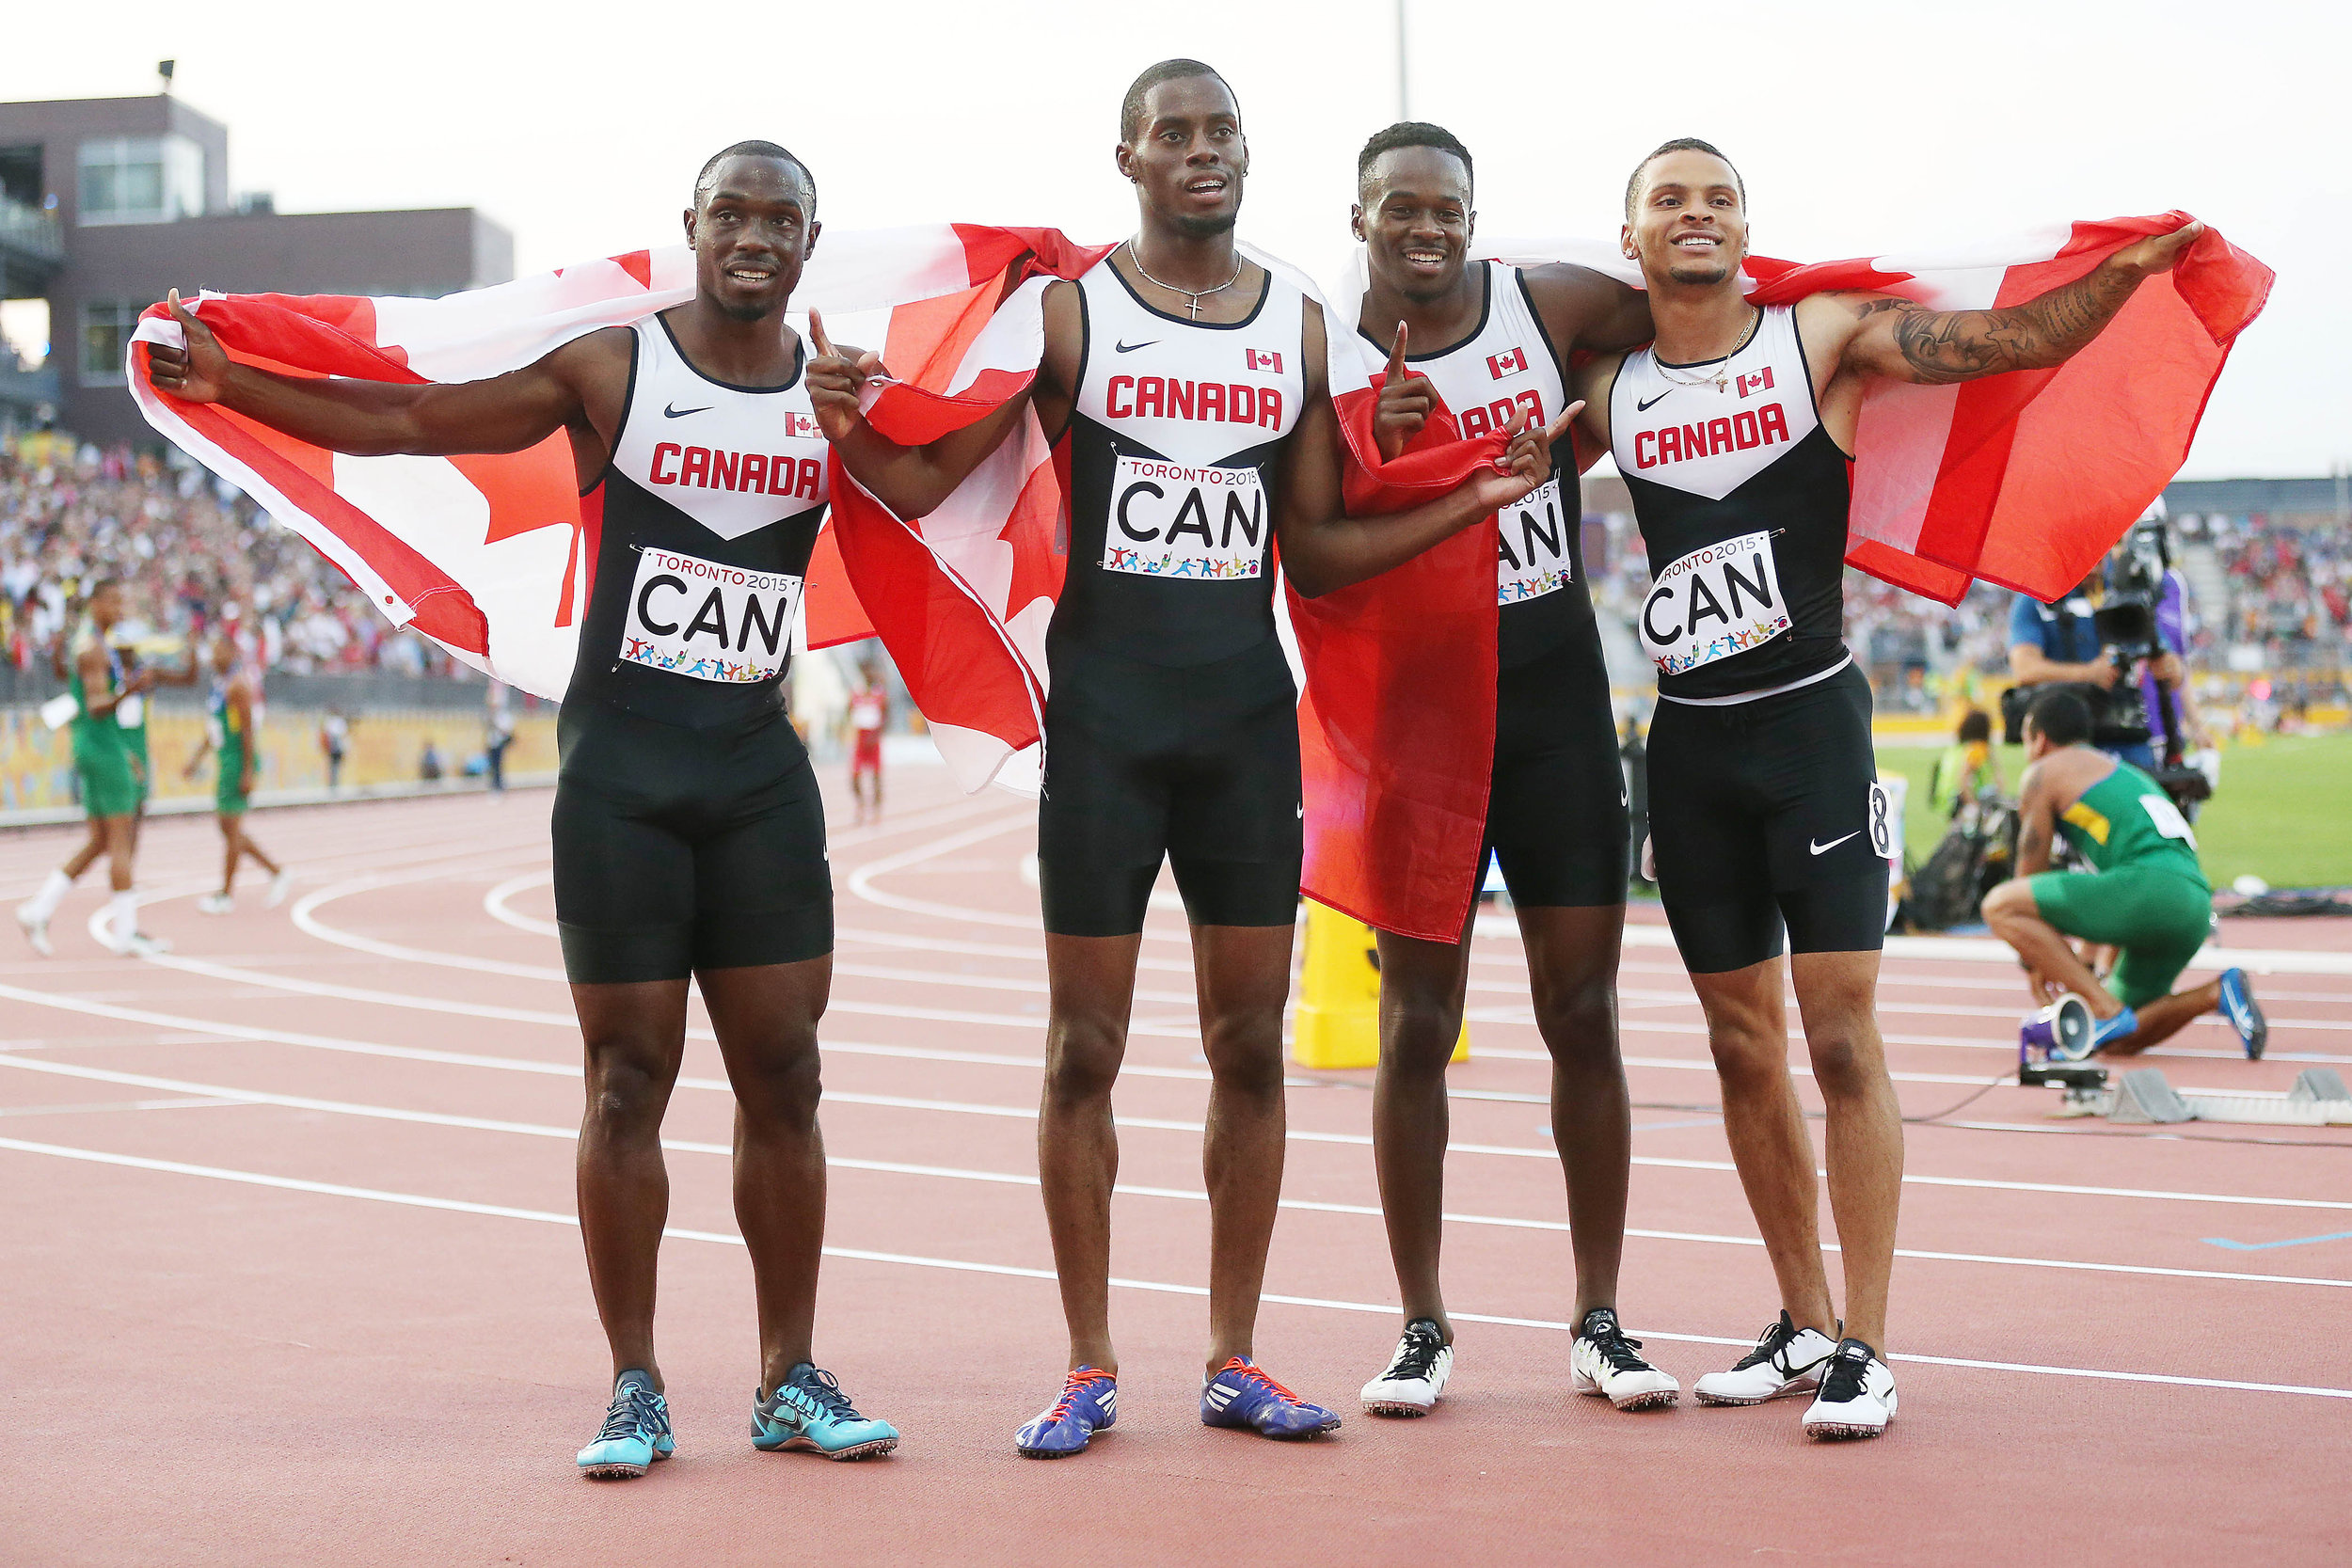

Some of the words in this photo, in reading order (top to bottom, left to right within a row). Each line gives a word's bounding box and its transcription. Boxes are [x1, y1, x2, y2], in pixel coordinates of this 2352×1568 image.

[1105, 374, 1283, 433] CANADA
[1634, 403, 1790, 470] CANADA
[648, 440, 821, 501] CANADA
[1130, 461, 1223, 484] TORONTO
[1224, 470, 1258, 485] 2015
[1116, 481, 1262, 549] CAN
[656, 553, 745, 585] TORONTO
[746, 575, 788, 593] 2015
[1714, 536, 1756, 561] 2015
[637, 574, 787, 656] CAN
[1643, 552, 1774, 647] CAN
[1872, 787, 1890, 855] 8
